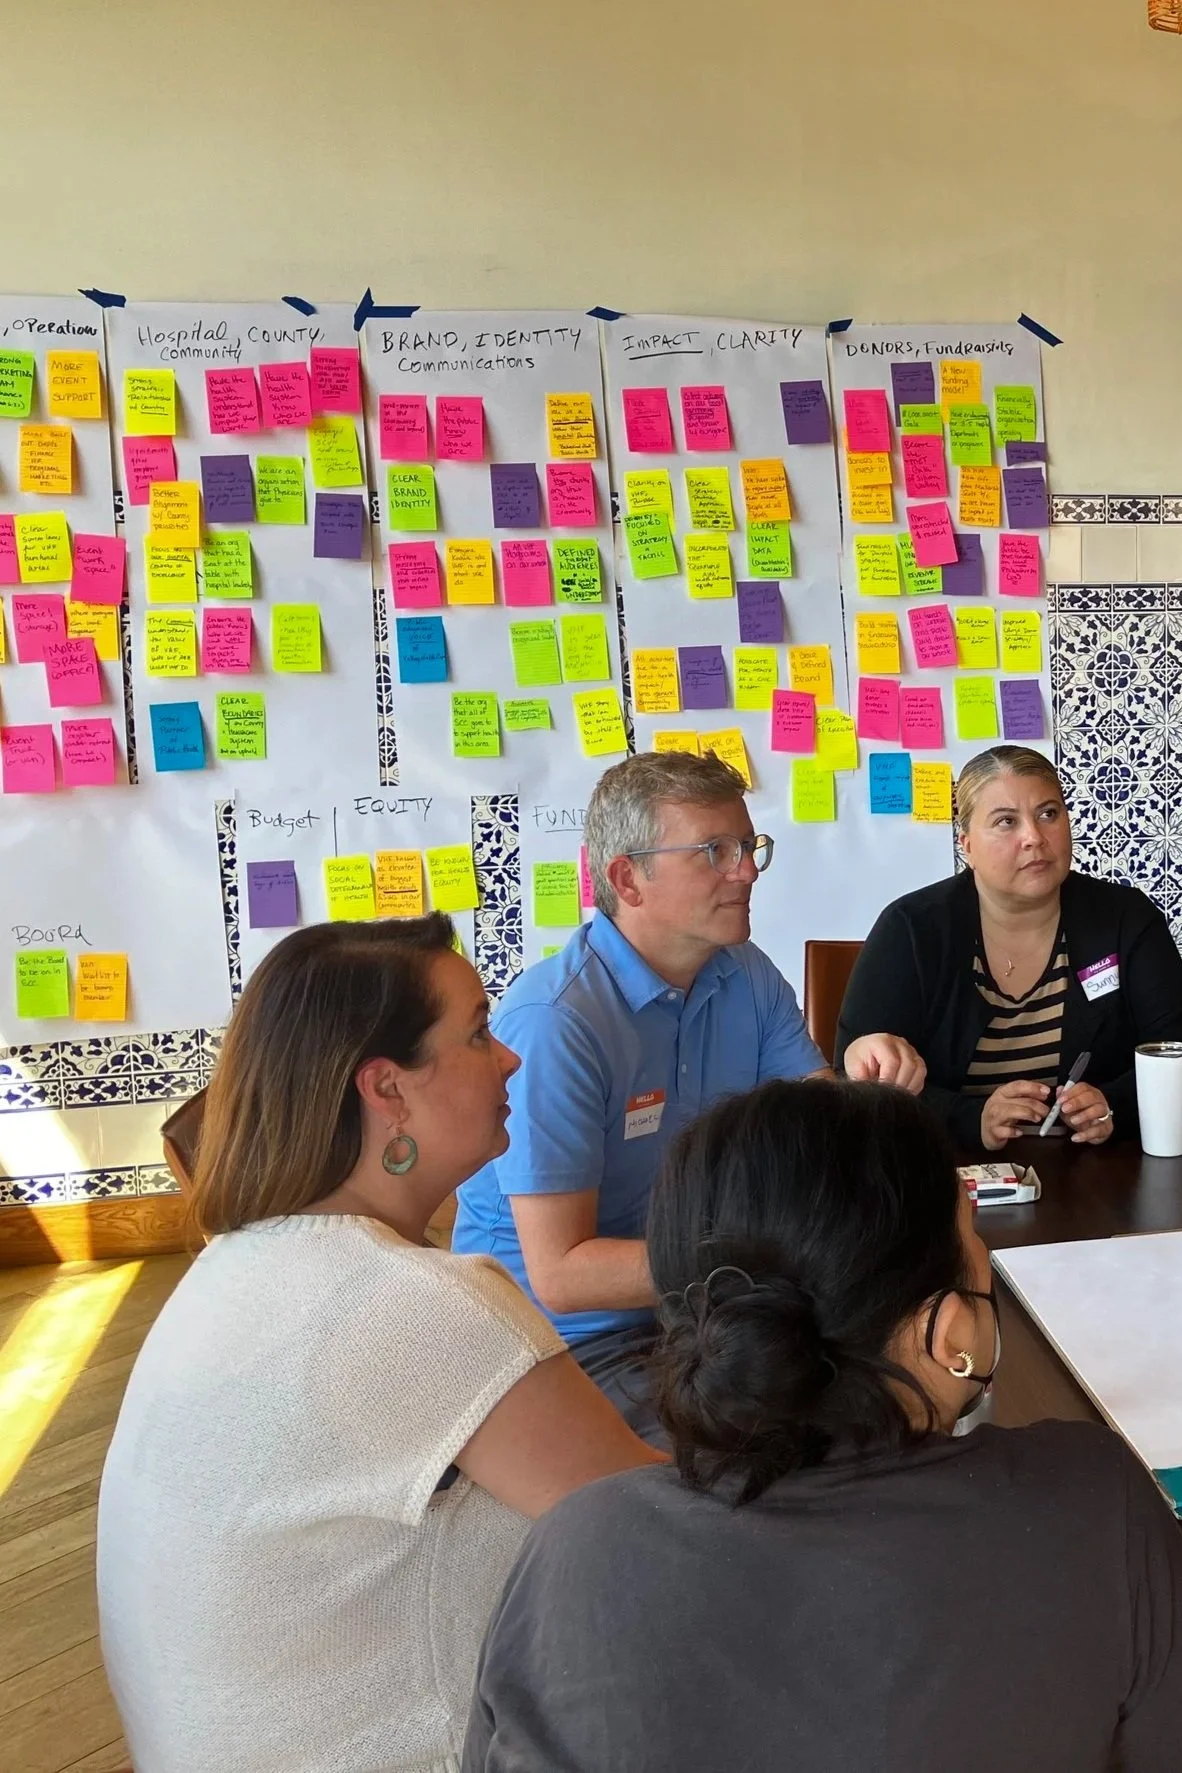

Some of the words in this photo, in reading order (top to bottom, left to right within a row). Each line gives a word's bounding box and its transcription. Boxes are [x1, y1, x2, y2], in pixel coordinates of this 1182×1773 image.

[475, 327, 582, 348] IDENTITY
[398, 356, 535, 374] Communications
[52, 376, 88, 386] EVENT
[53, 392, 97, 402] SUPPORT
[392, 474, 422, 483] CLEAR
[393, 487, 427, 498] BRAND
[390, 499, 431, 509] IDENTITY
[751, 522, 779, 531] CLEAR
[352, 796, 433, 822] EQUITY
